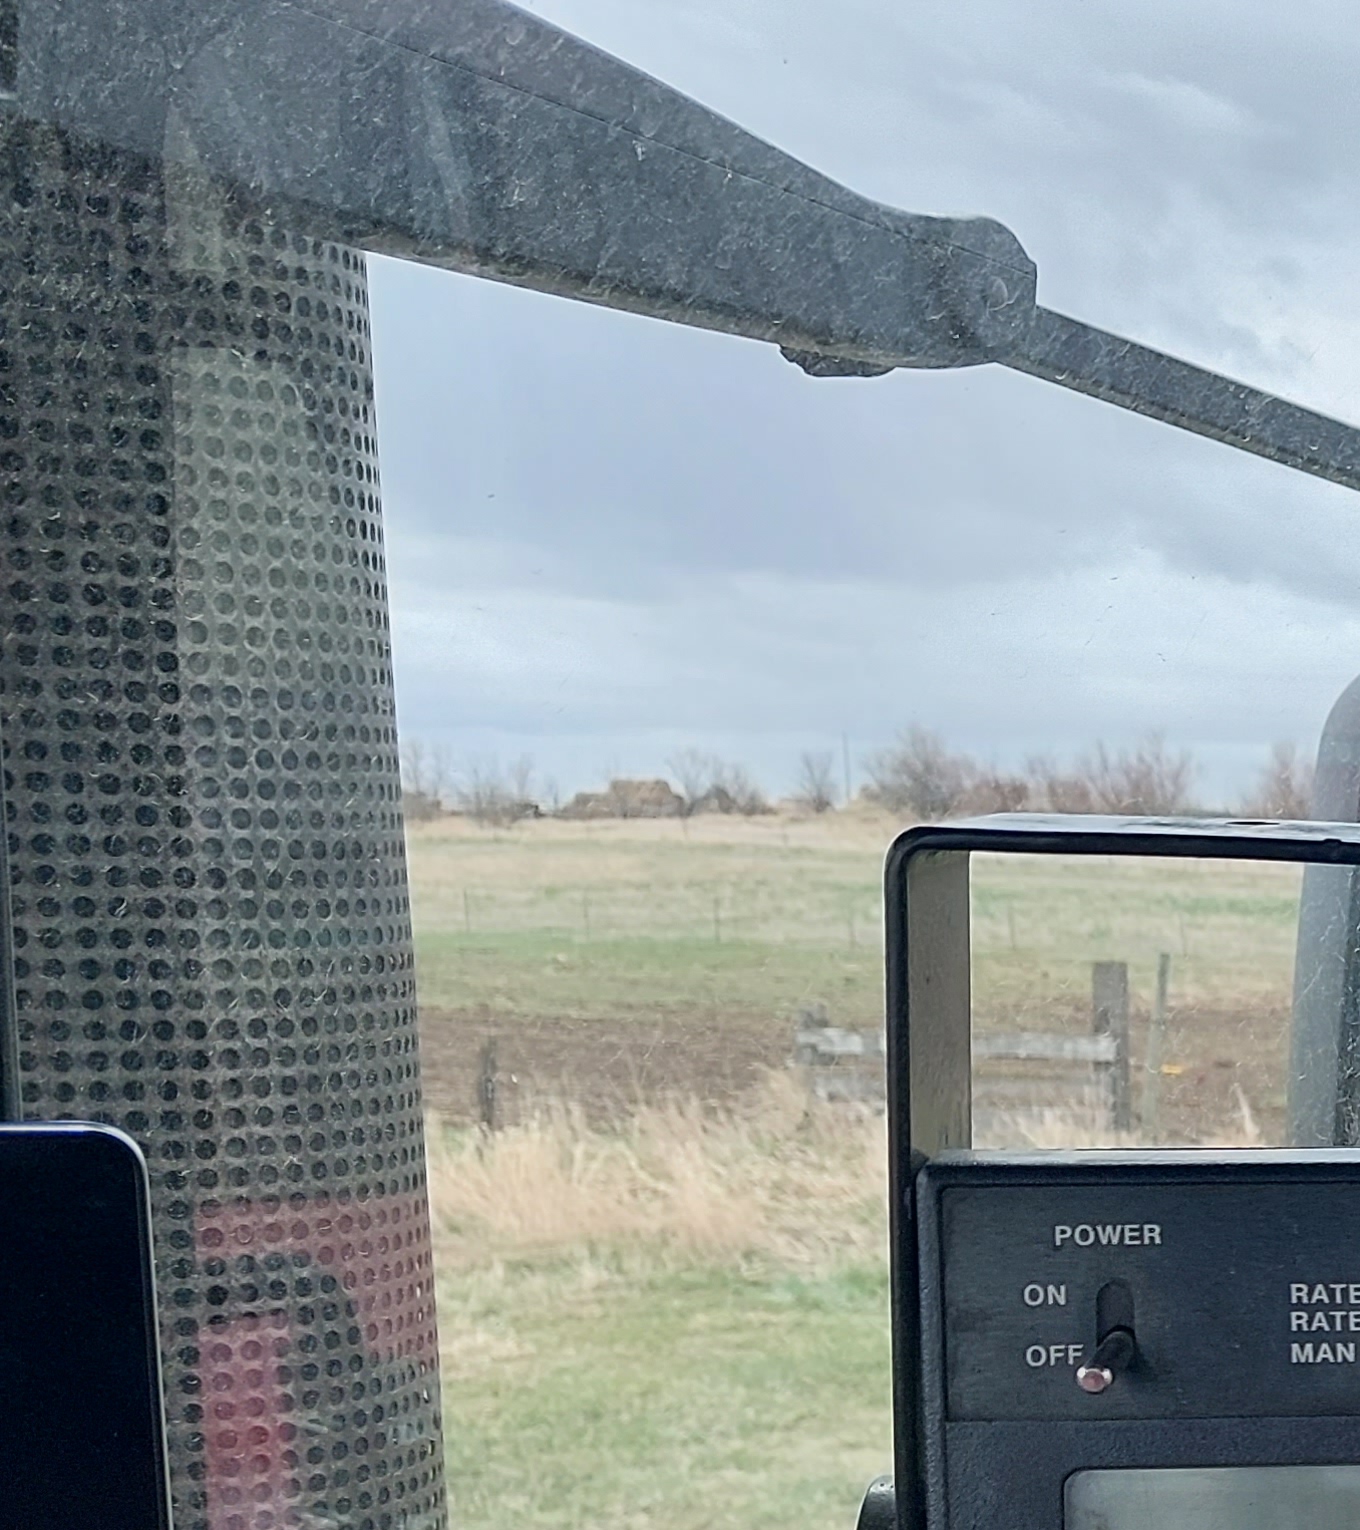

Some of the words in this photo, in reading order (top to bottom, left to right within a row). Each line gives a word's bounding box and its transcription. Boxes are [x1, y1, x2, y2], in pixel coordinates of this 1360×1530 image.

[1054, 1224, 1162, 1246] POWER
[1023, 1284, 1066, 1306] ON
[1026, 1345, 1083, 1367] OFF
[1291, 1343, 1356, 1363] MAN
